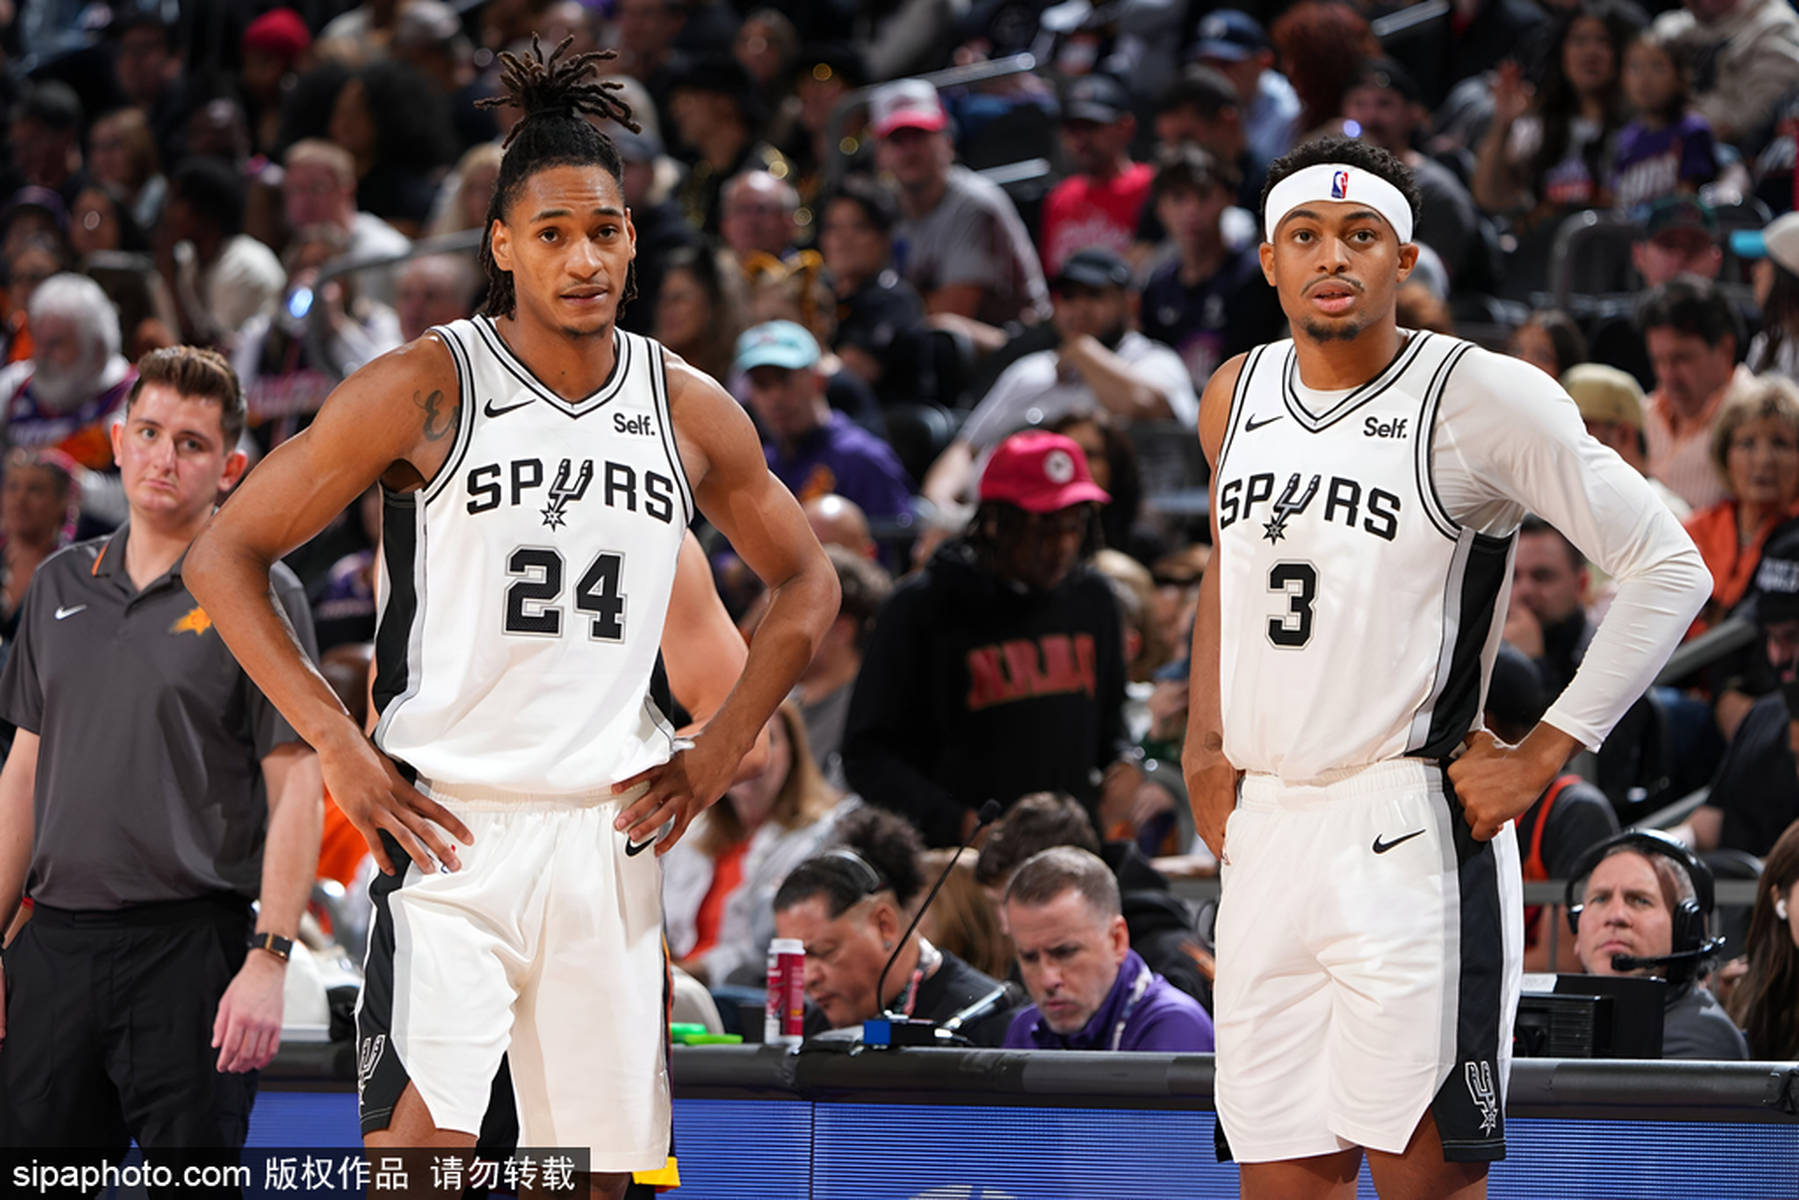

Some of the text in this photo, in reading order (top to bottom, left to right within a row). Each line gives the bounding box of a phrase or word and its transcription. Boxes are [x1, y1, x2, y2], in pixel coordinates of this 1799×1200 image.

[613, 412, 656, 436] Self.
[1363, 416, 1408, 439] Self.
[466, 457, 674, 532] SPURS
[1220, 472, 1401, 545] SPURS
[501, 544, 628, 645] 24
[1265, 559, 1321, 651] 3
